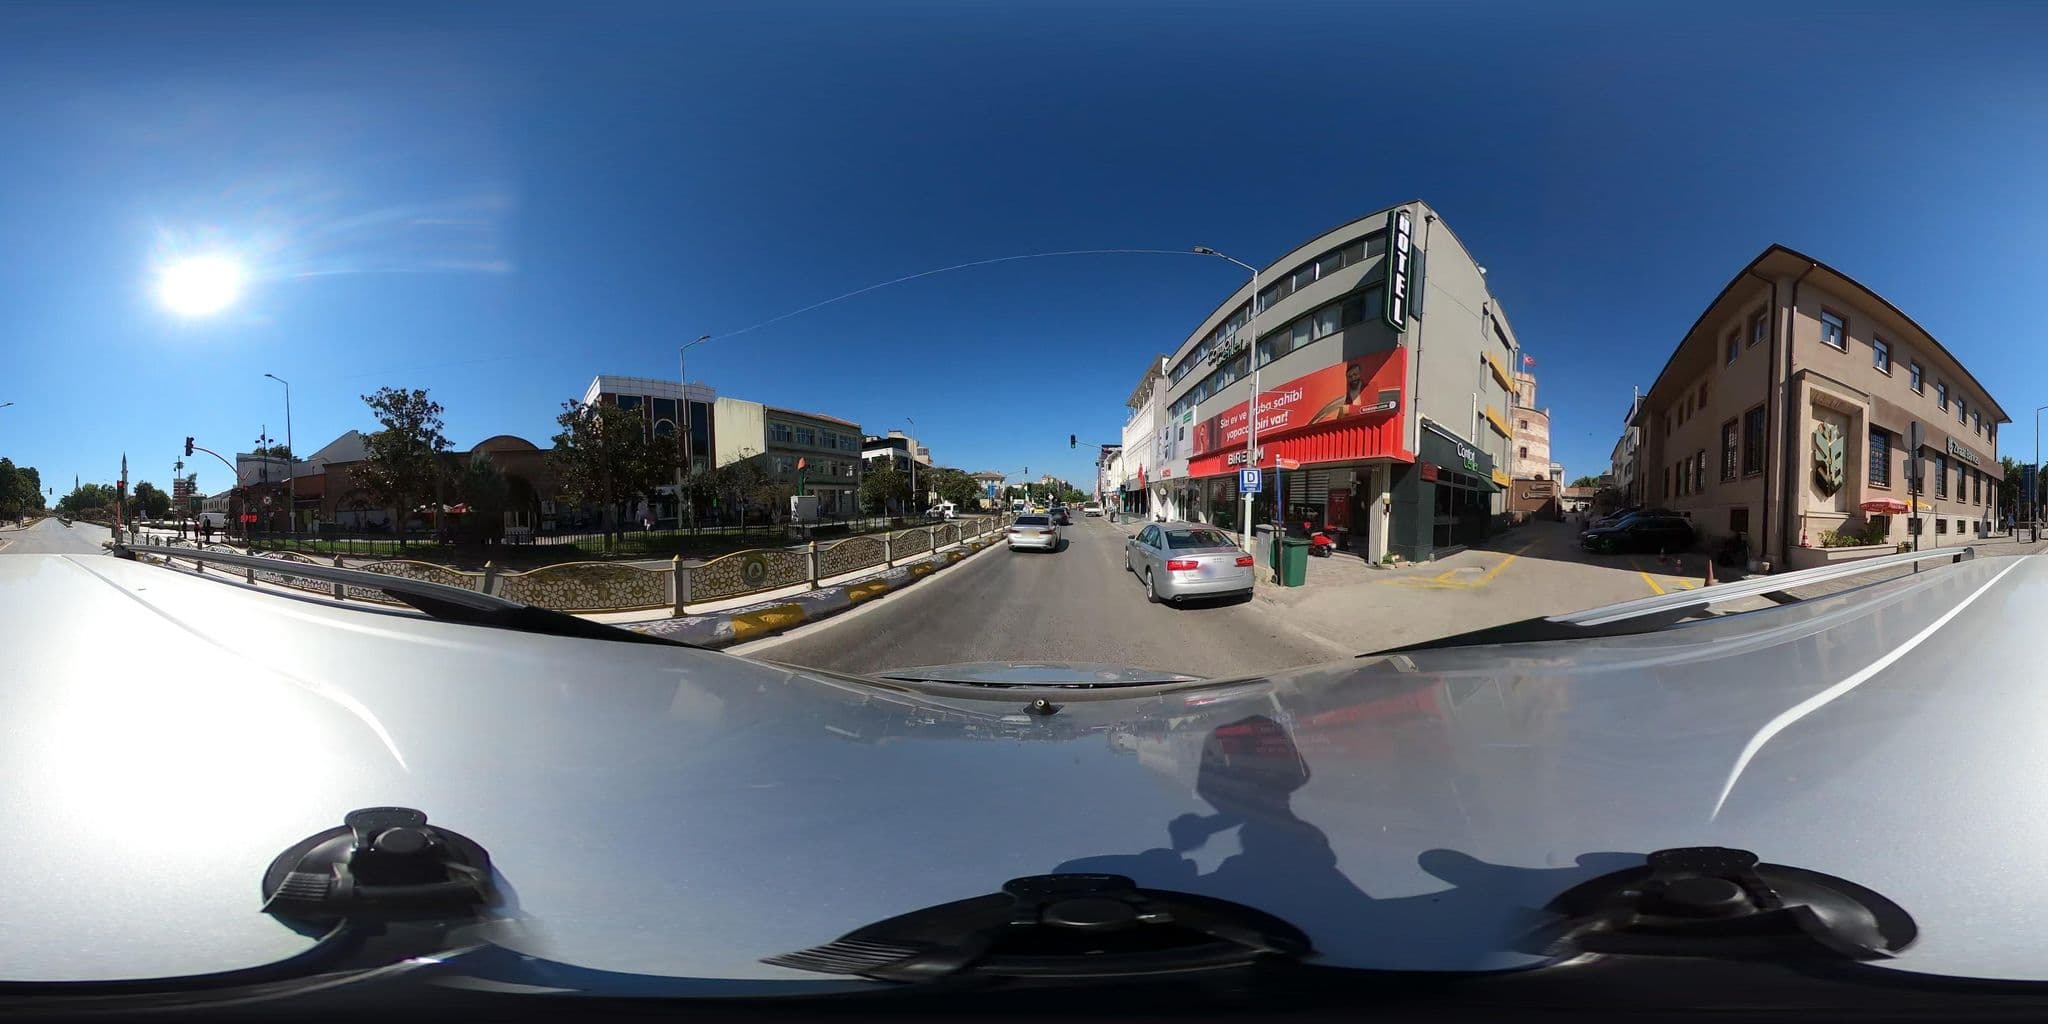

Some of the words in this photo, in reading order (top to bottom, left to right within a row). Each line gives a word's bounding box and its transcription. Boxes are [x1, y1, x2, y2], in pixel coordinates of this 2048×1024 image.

[1393, 213, 1411, 326] HOTEL
[1239, 411, 1248, 421] ve
[1273, 387, 1303, 408] sahibi
[1226, 425, 1250, 442] yapaca
[1270, 411, 1288, 426] var!
[1247, 471, 1256, 483] D
